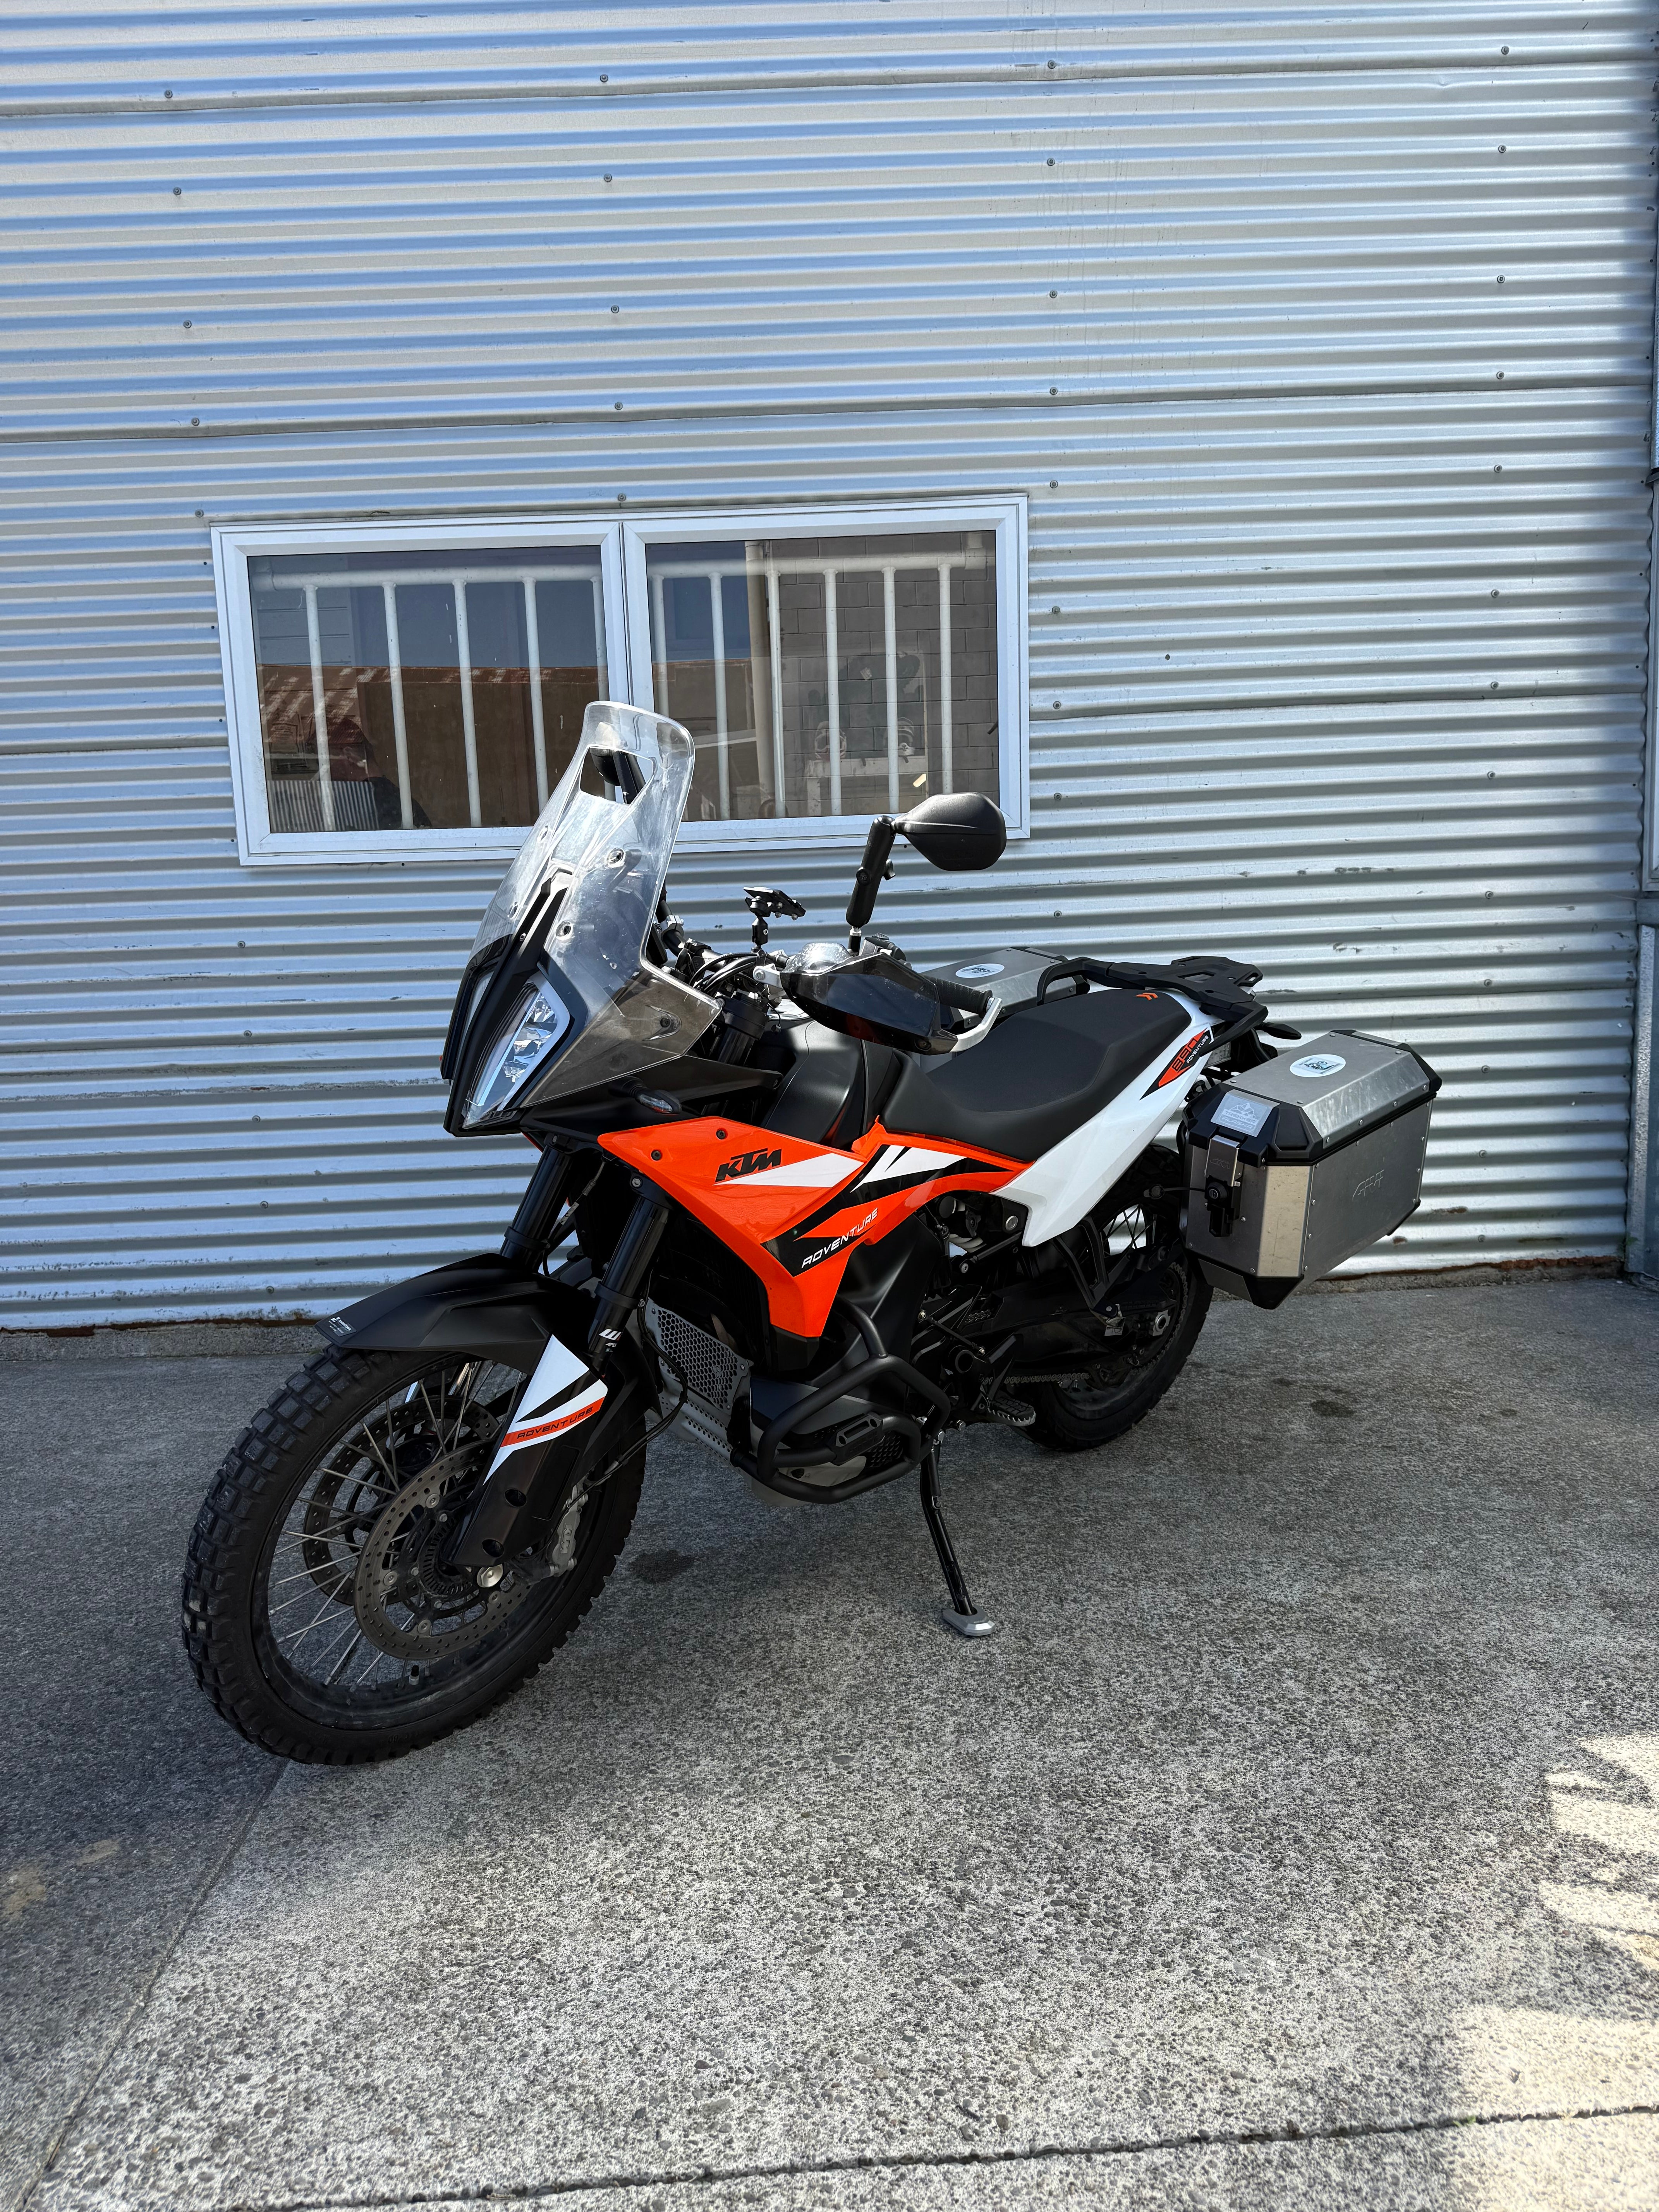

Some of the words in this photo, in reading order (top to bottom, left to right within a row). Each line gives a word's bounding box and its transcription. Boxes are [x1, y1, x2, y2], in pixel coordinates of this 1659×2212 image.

[1171, 1037, 1198, 1072] 890
[1186, 1035, 1209, 1064] ADVENTURE
[1221, 1116, 1253, 1128] ALASKA
[1225, 1111, 1256, 1123] TREKKER
[715, 1148, 782, 1182] KTM
[801, 1207, 878, 1268] ADVENTURE
[517, 1406, 593, 1439] ADVENTURE
[561, 1524, 573, 1554] KTM
